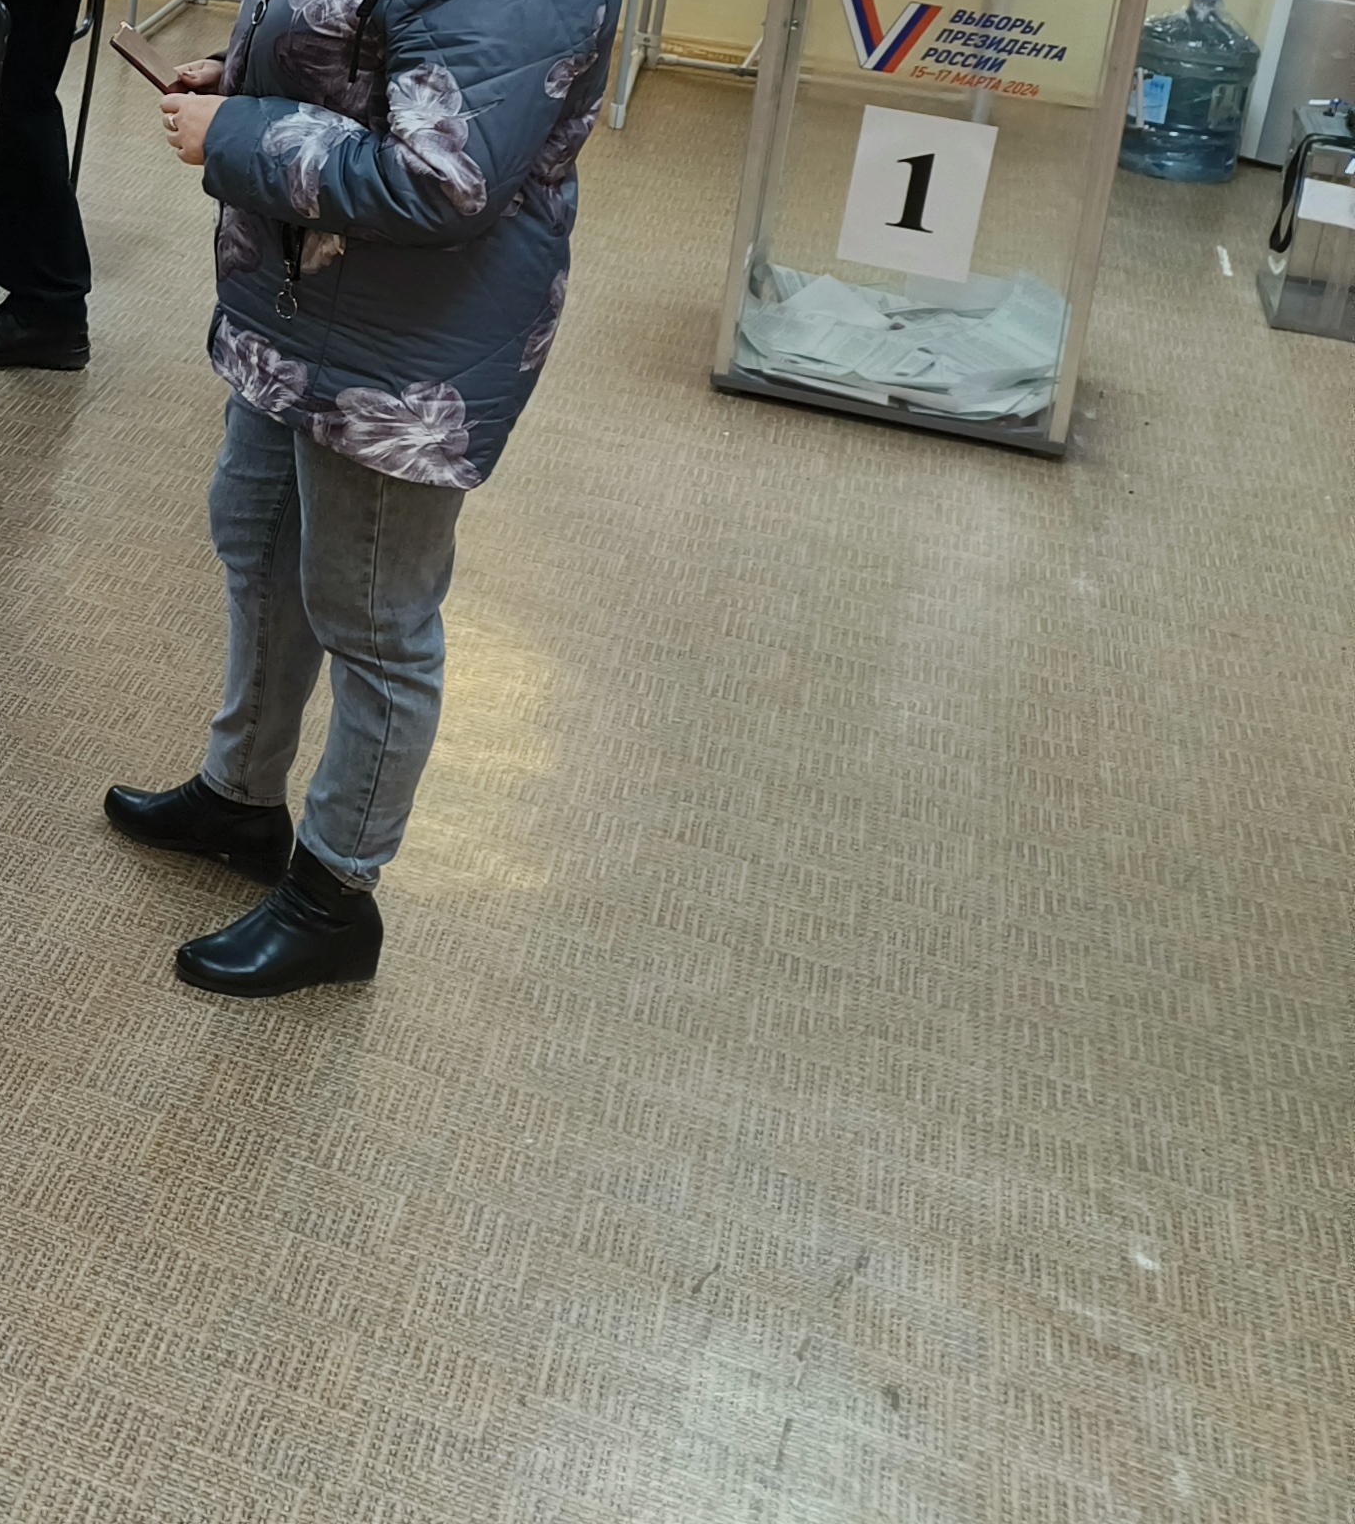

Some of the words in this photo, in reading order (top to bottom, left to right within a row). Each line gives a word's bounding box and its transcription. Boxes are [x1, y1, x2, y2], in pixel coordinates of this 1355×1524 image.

[949, 8, 1045, 36] ВЫБОРЫ
[934, 27, 1068, 62] ПРЕЗИДЕНТА
[920, 47, 1008, 74] РОССИИ
[950, 71, 1002, 92] МАРТА
[1002, 79, 1040, 98] 2024
[884, 153, 936, 234] 1
